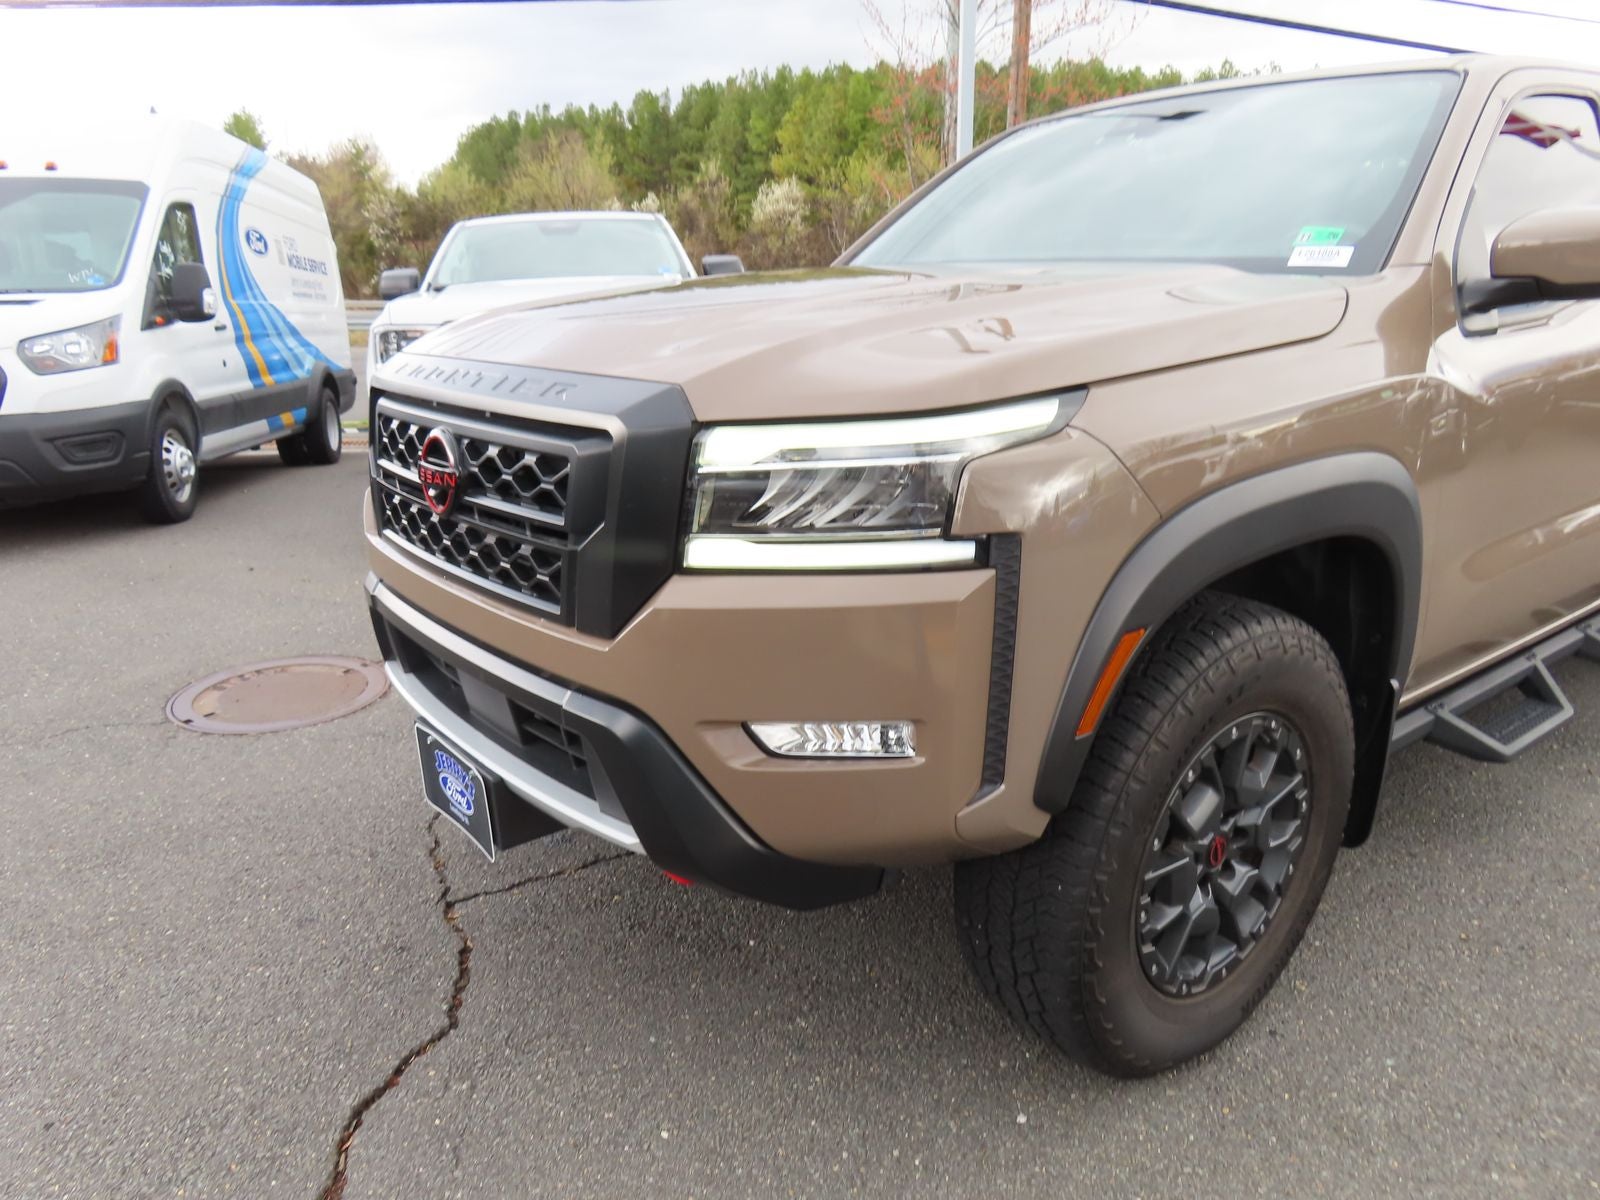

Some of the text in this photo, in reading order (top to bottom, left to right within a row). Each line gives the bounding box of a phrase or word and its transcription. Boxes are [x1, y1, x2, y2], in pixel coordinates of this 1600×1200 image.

[287, 252, 328, 276] MOBILE SERVICE
[419, 466, 457, 488] SSAN
[445, 778, 469, 810] Ford
